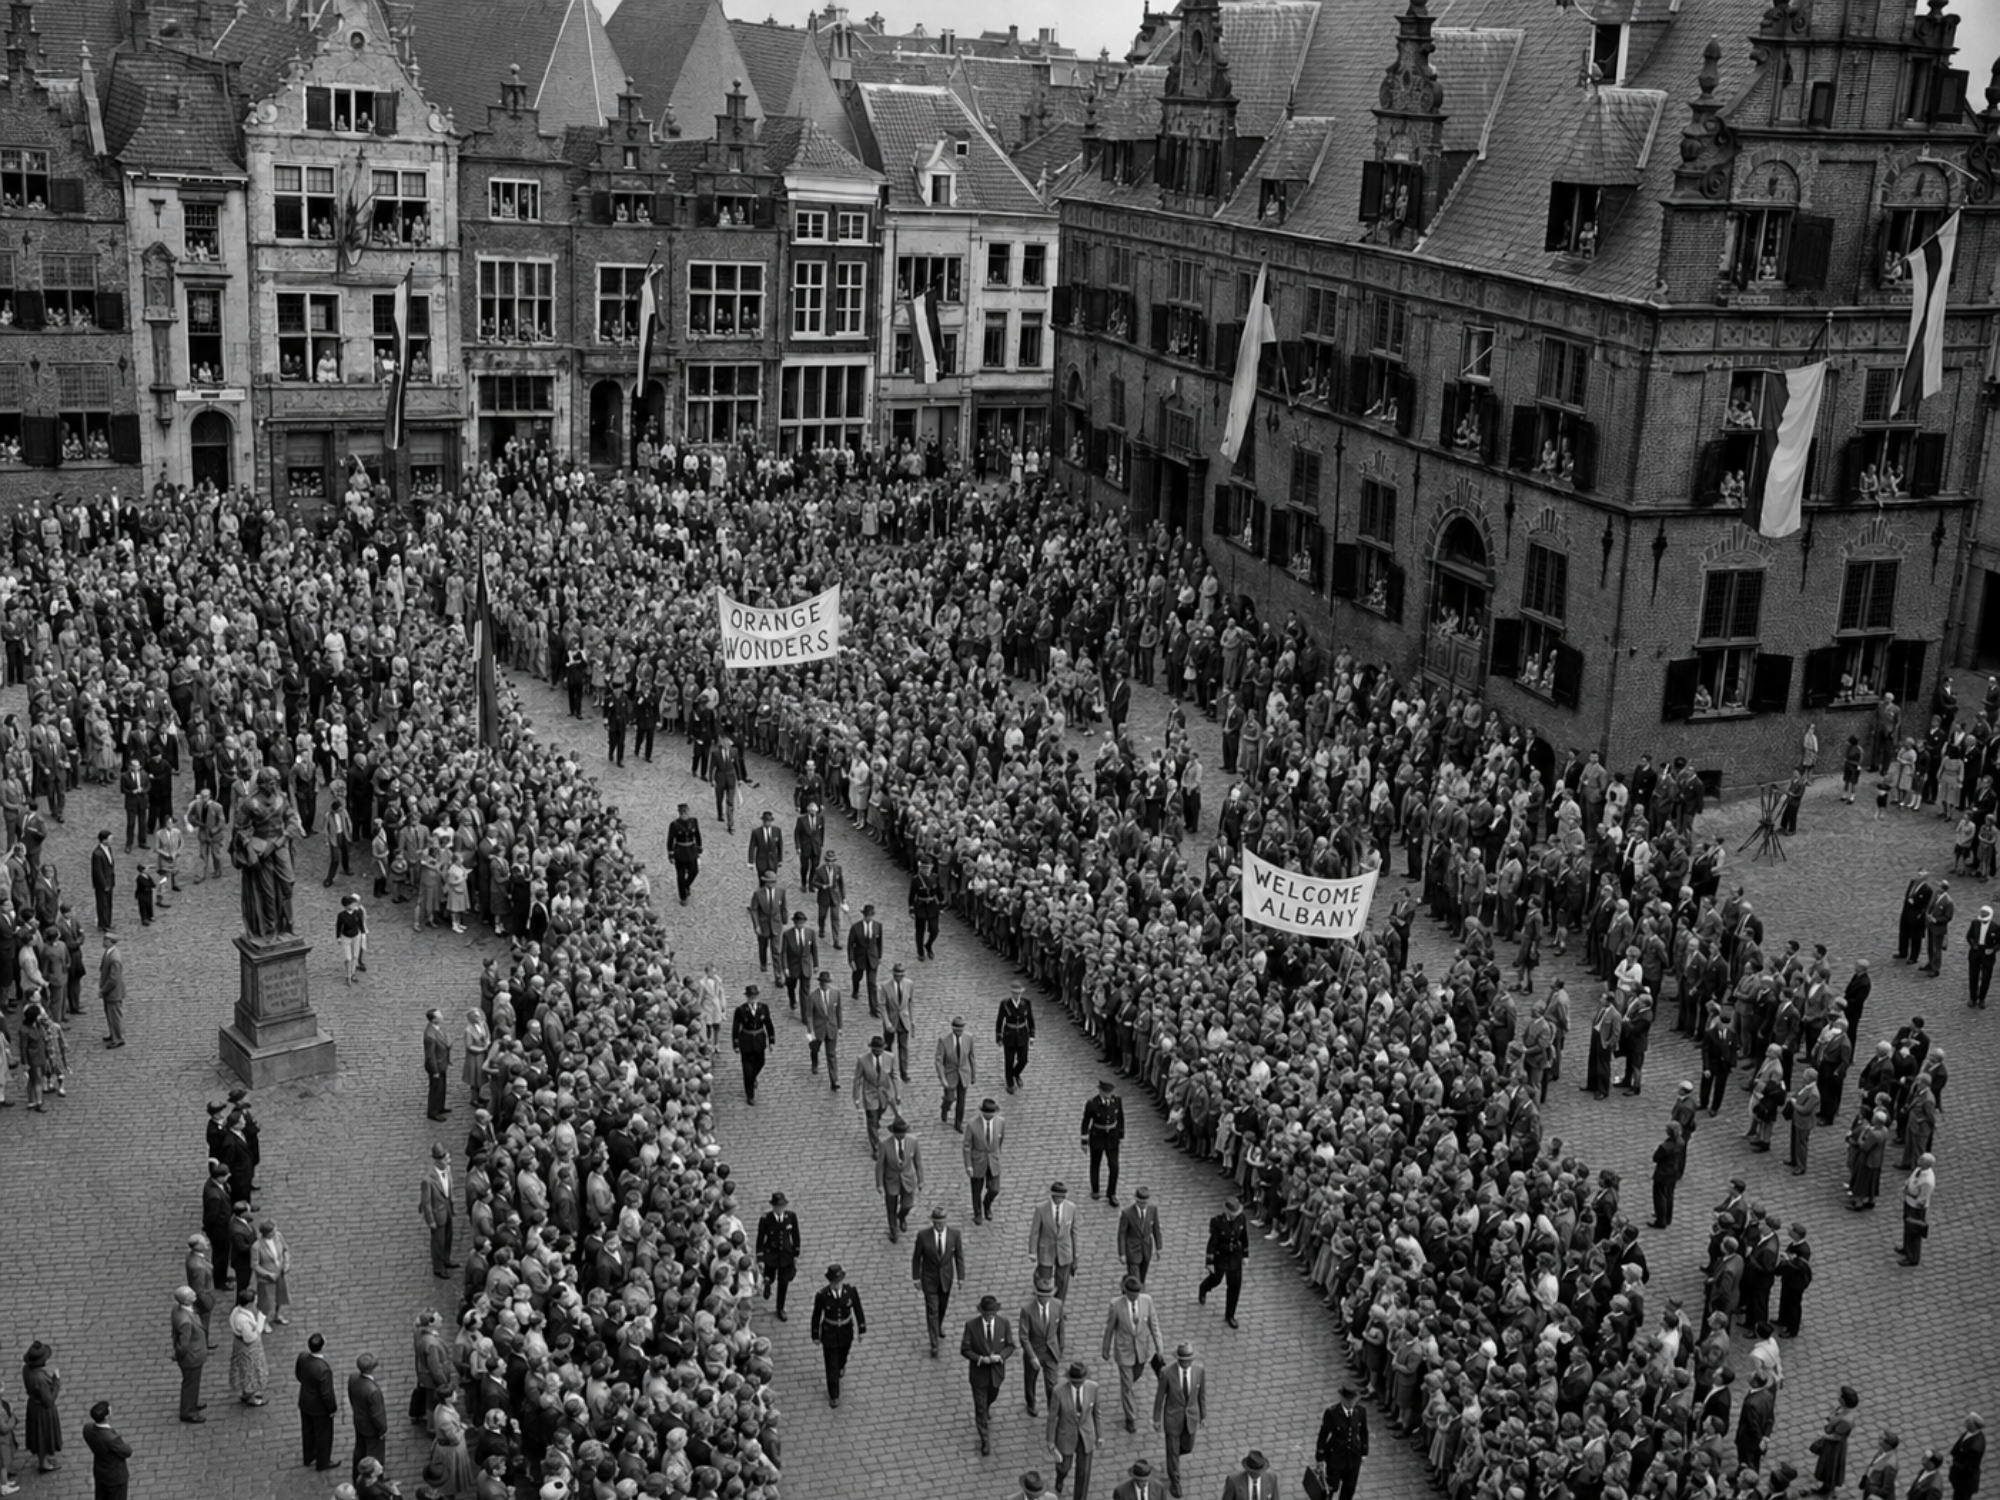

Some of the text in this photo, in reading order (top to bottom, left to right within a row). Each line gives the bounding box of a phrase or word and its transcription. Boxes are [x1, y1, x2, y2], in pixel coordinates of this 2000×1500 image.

[731, 602, 821, 632] ORANGE
[725, 629, 829, 660] WONDERS
[1253, 864, 1363, 905] WELCOME
[1260, 897, 1358, 928] ALBANY
